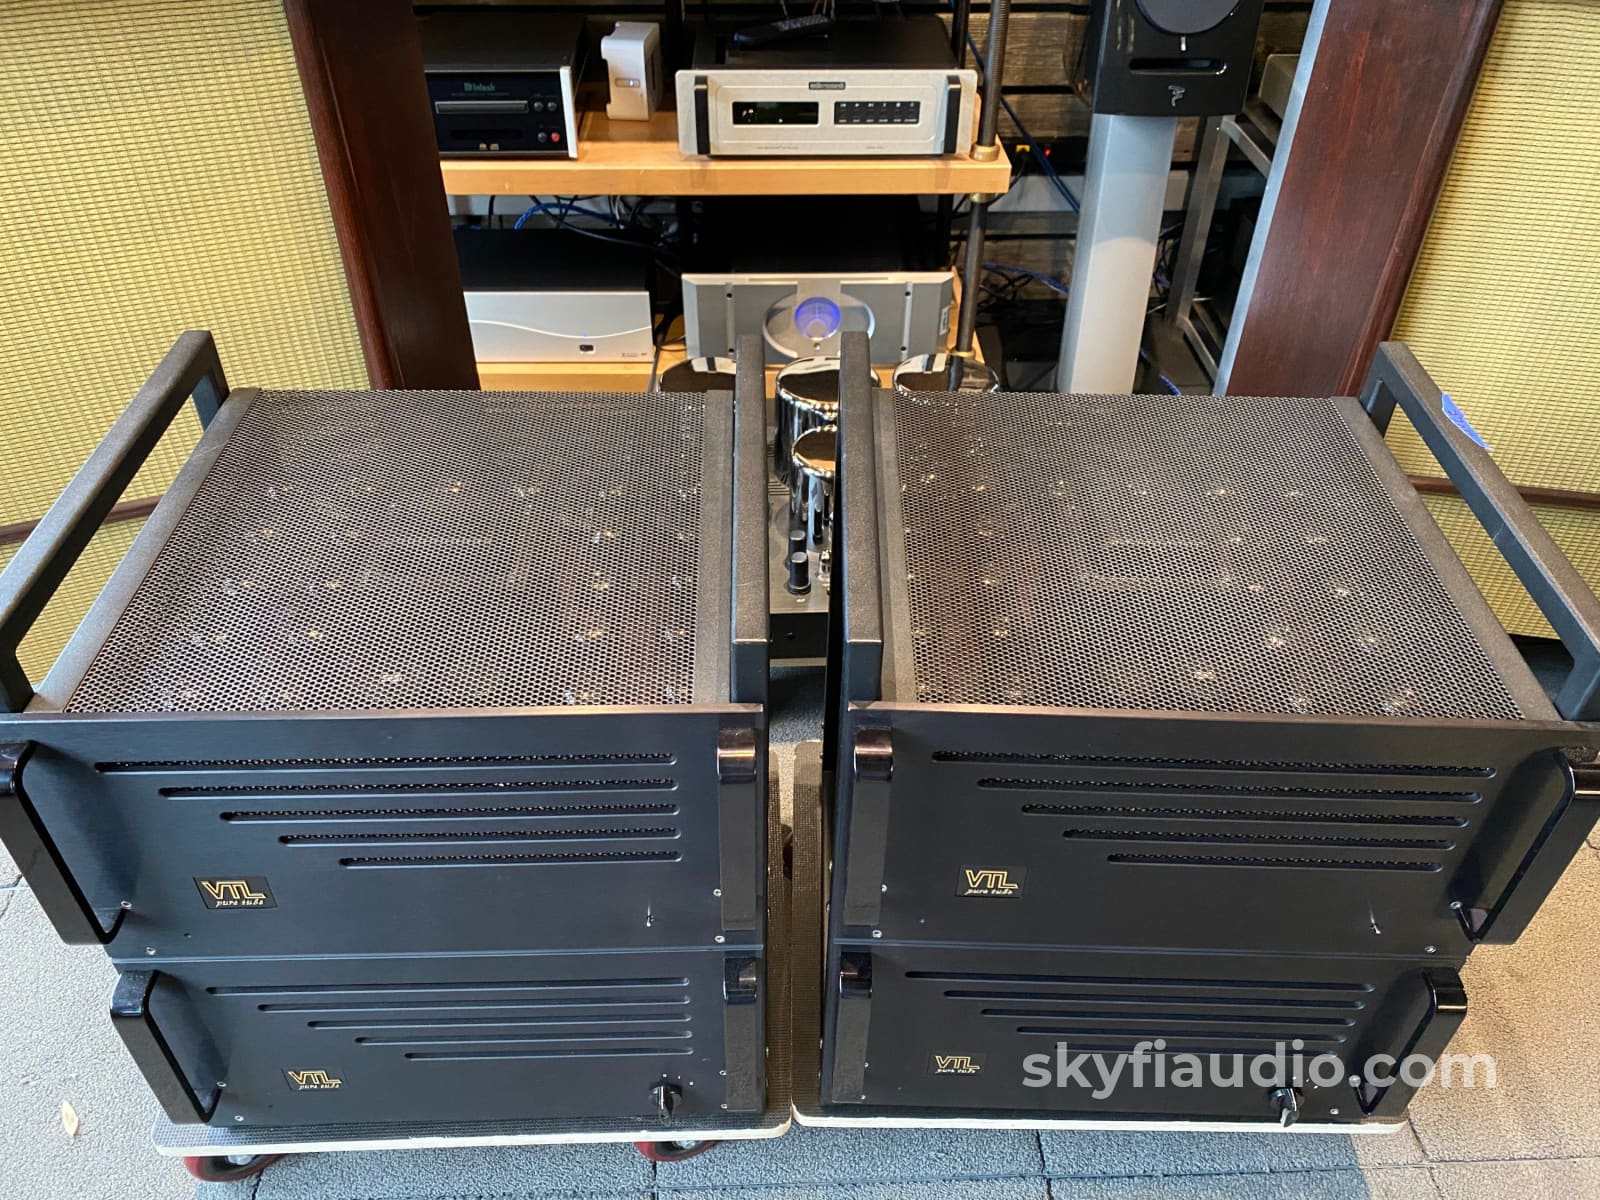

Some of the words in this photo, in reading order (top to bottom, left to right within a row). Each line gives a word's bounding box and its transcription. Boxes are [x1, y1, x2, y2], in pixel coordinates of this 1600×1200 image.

[965, 869, 1019, 889] VTL
[201, 881, 267, 900] VTL
[935, 1055, 980, 1069] VTL
[287, 1070, 342, 1085] VTL
